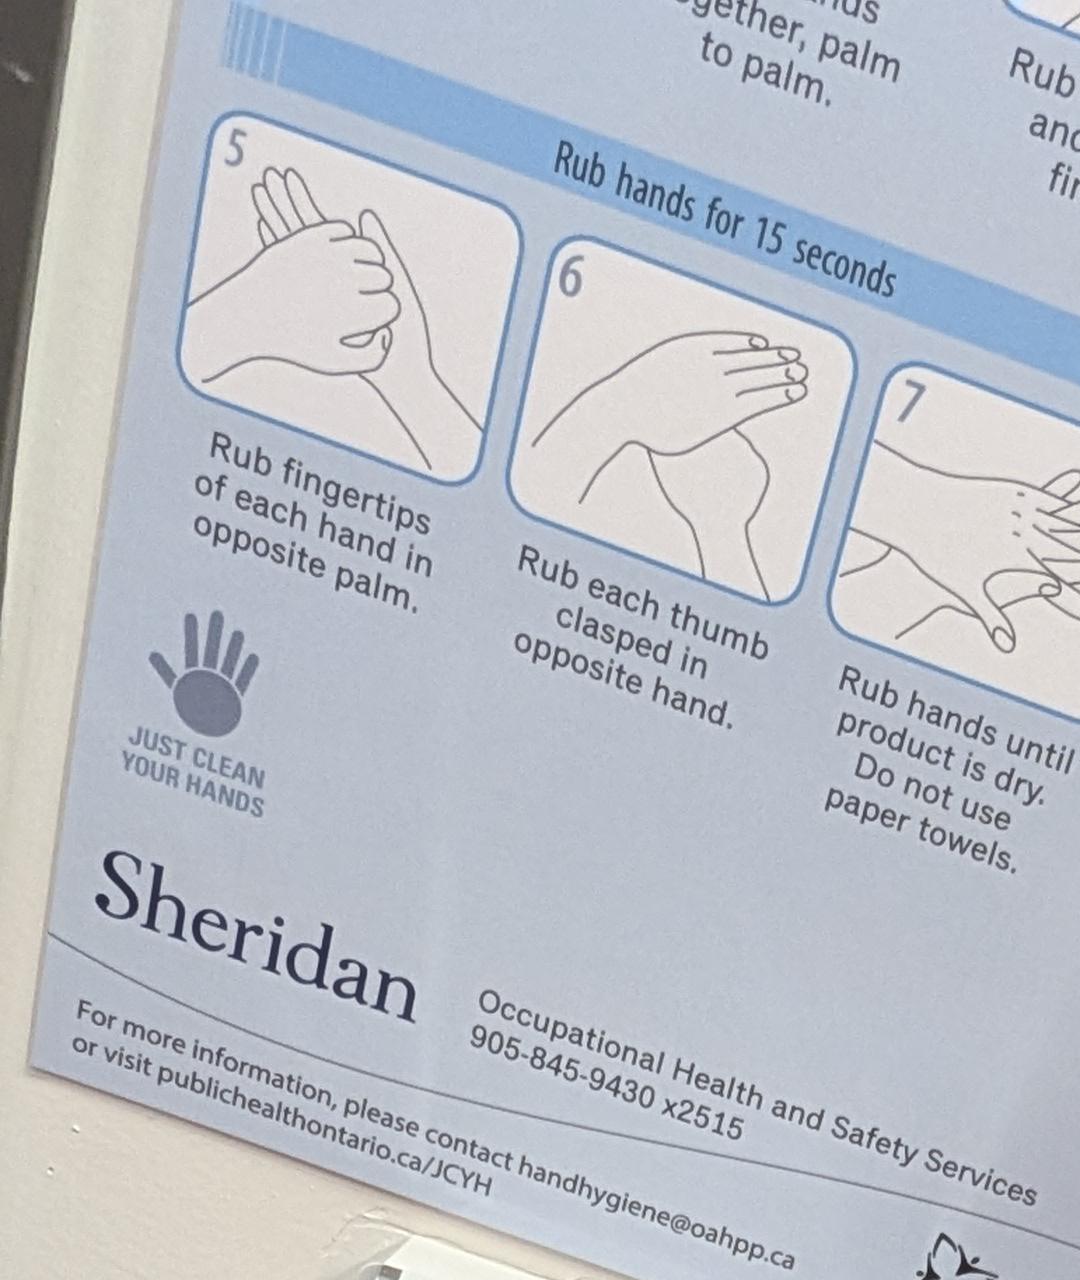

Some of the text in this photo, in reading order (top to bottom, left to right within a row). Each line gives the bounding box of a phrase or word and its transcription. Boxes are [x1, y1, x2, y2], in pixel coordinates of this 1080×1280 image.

[676, 0, 806, 54] gether,
[817, 31, 901, 84] palm
[701, 31, 832, 108] to palm.
[1009, 46, 1076, 99] Rub
[224, 130, 246, 167] 5
[553, 139, 897, 298] Rub hands for 15 seconds
[558, 254, 585, 298] 6
[896, 379, 927, 424] 7
[194, 473, 433, 578] of each hand in
[209, 430, 431, 536] Rub fingertips
[193, 515, 418, 614] opposite palm.
[517, 543, 769, 661] Rub each thumb
[513, 632, 733, 730] opposite hand.
[556, 605, 708, 680] clasped in
[127, 725, 266, 790] JUST CLEAN
[836, 711, 1045, 807] product is dry.
[838, 664, 1076, 775] Rub hands until
[121, 749, 265, 818] YOUR HANDS
[824, 787, 1017, 875] paper towels.
[854, 751, 1012, 831] Do not use
[94, 850, 416, 1025] Sheridan
[72, 1036, 493, 1197] or visit publichealthontario.ca/JCYH
[469, 1023, 745, 1141] 905-845-9430 x2515
[478, 988, 1038, 1207] Occupational Health and Safety Services
[76, 998, 796, 1271] For more information, please contact handhygiene@oahpp.ca
